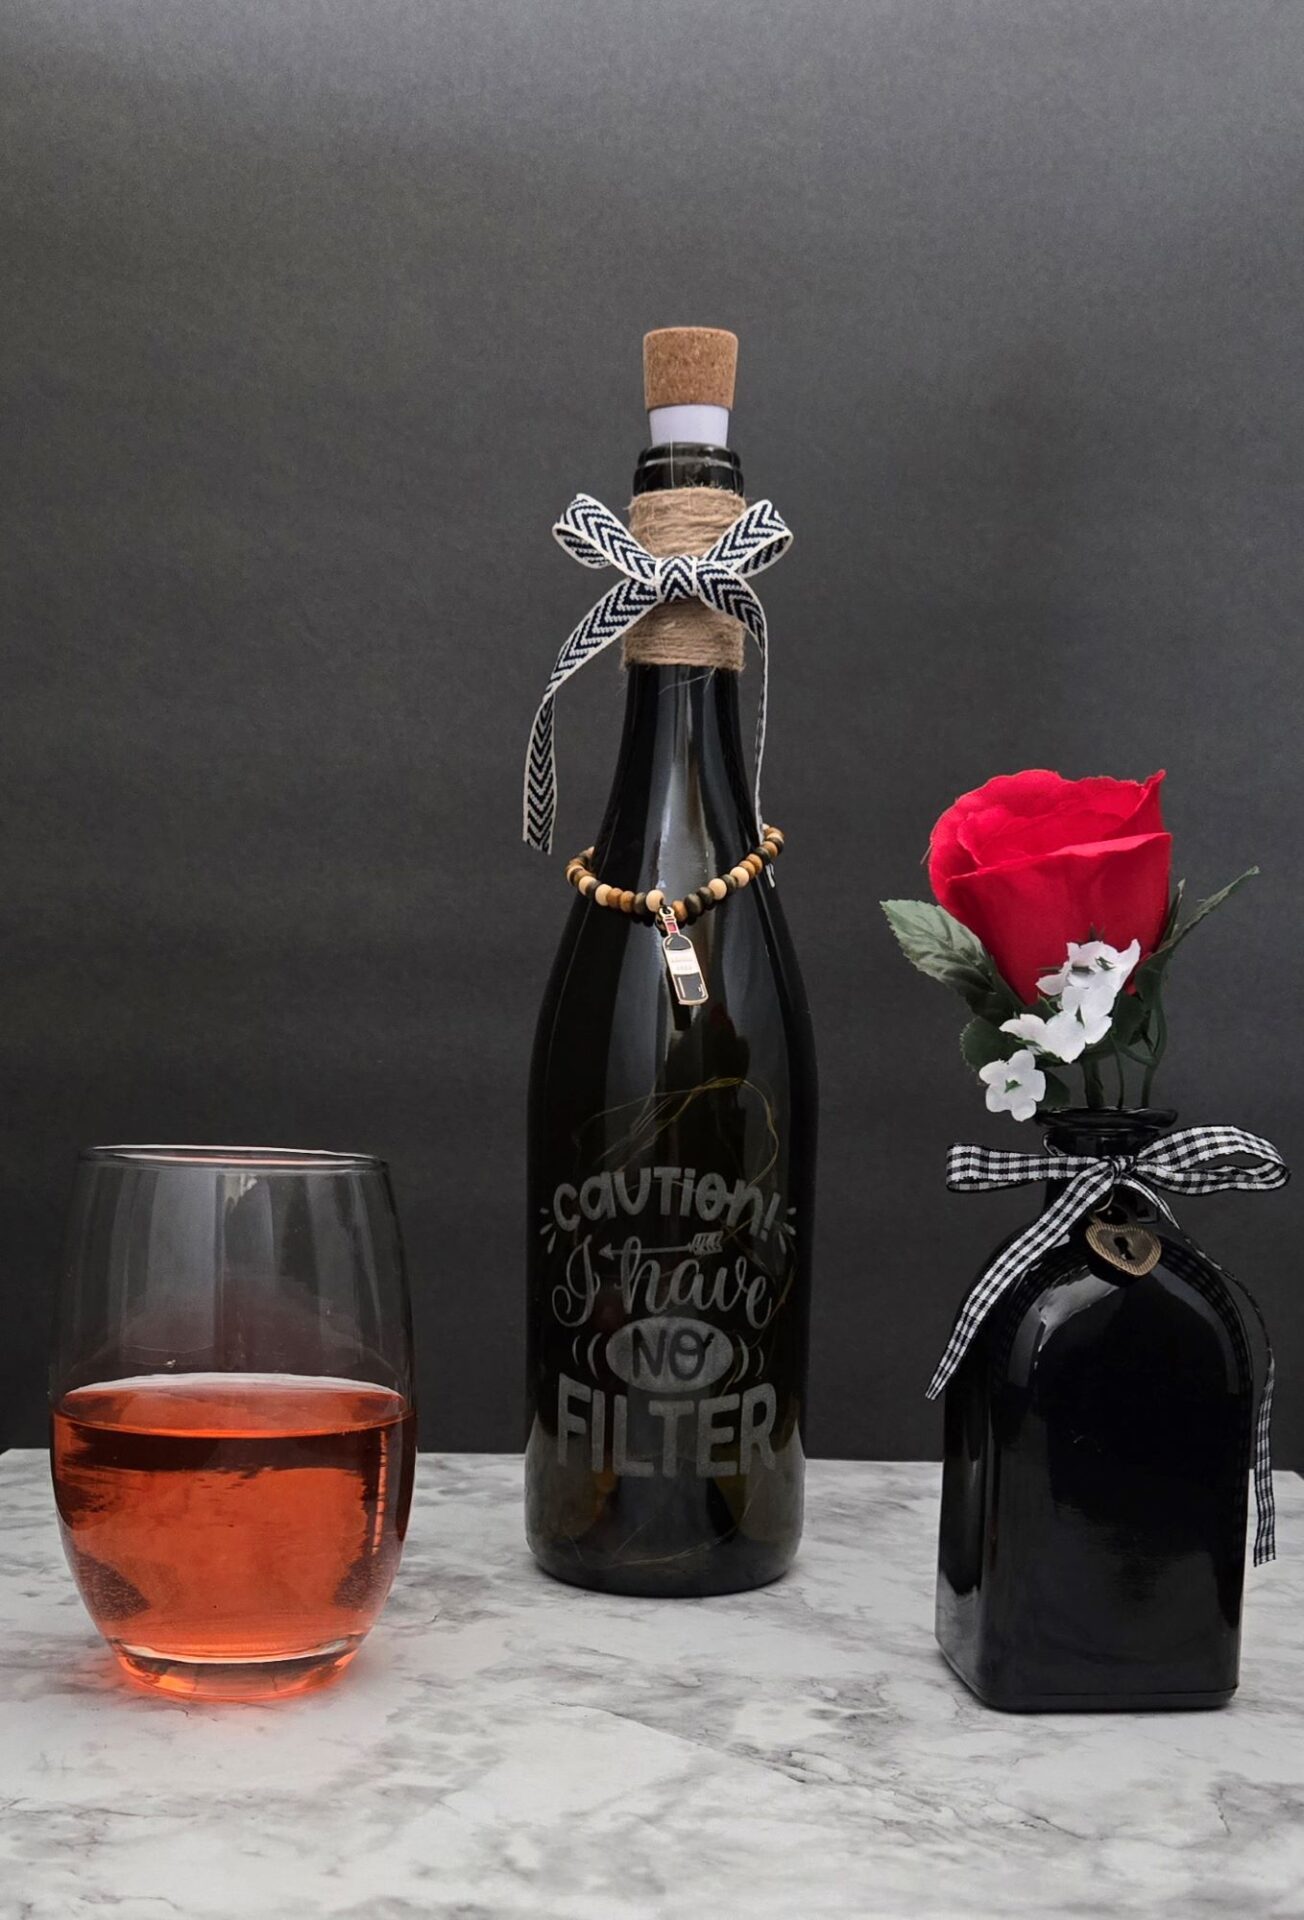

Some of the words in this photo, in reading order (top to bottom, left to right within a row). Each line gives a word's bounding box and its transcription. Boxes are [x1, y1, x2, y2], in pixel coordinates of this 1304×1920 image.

[552, 1234, 600, 1327] I
[613, 1236, 772, 1329] have
[631, 1326, 715, 1380] NO
[557, 1372, 777, 1477] FILTER
